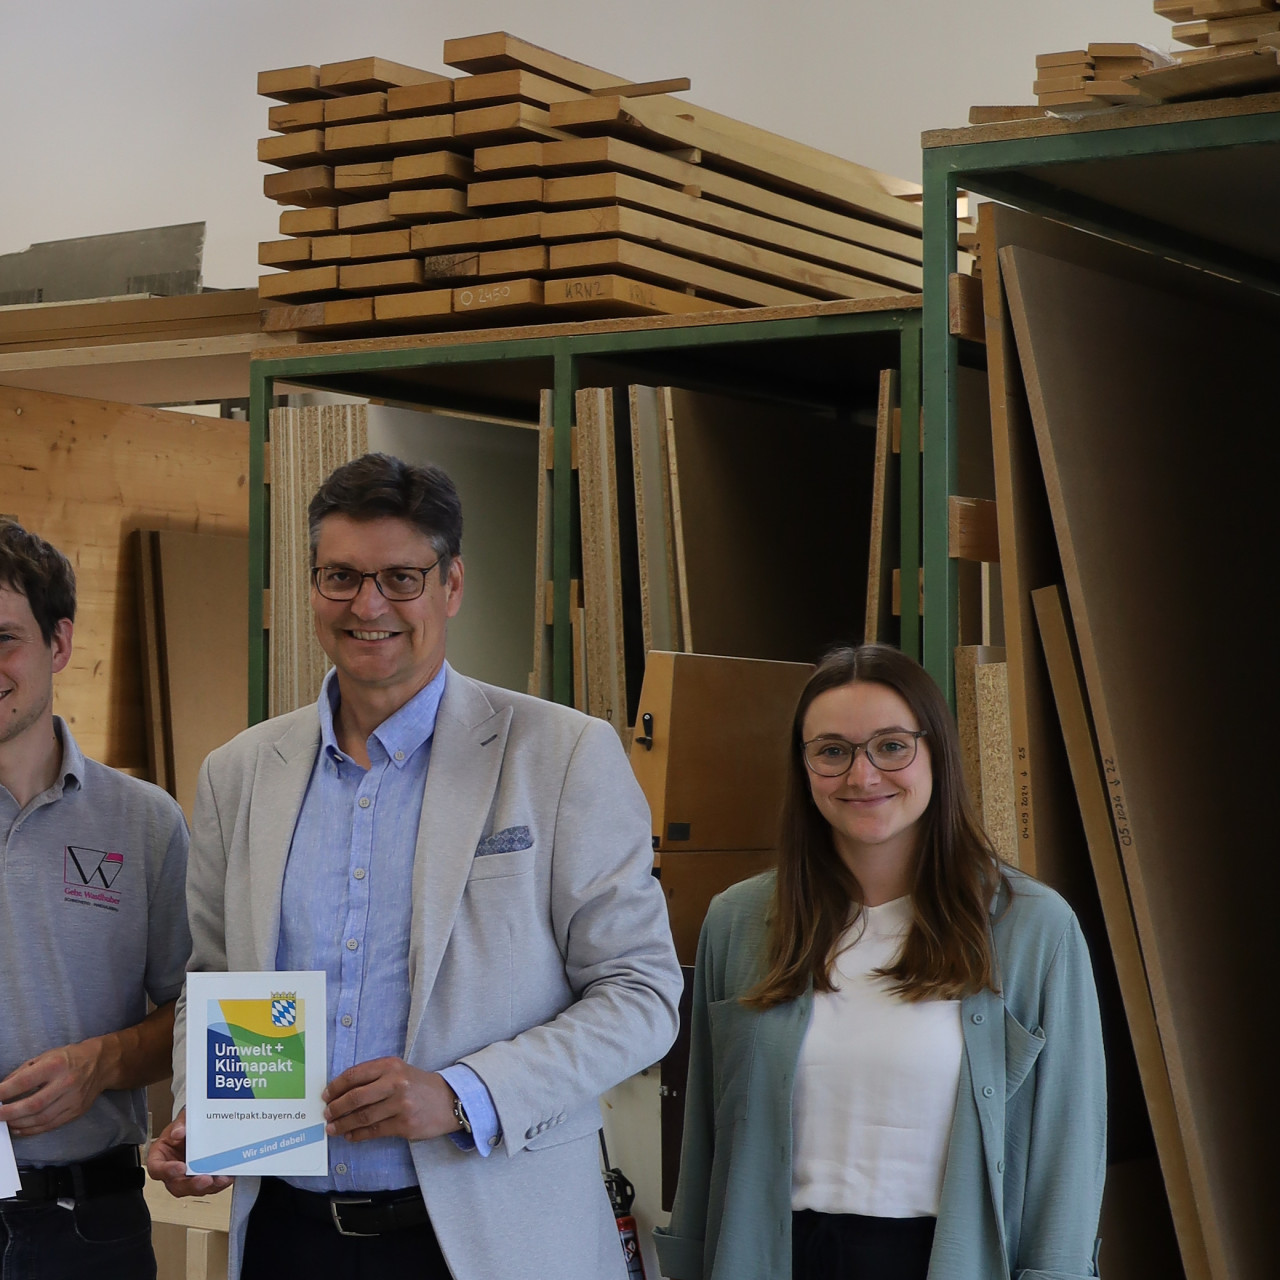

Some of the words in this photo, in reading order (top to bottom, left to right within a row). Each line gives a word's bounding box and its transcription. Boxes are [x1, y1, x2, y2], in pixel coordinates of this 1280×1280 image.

[215, 1043, 272, 1057] Umwelt
[215, 1059, 293, 1075] Klimapakt
[215, 1075, 268, 1091] Bayern
[206, 1111, 307, 1121] umweltpakt.bayern.de
[242, 1148, 258, 1160] Wir
[259, 1140, 279, 1155] sind
[279, 1132, 307, 1151] dabei!
